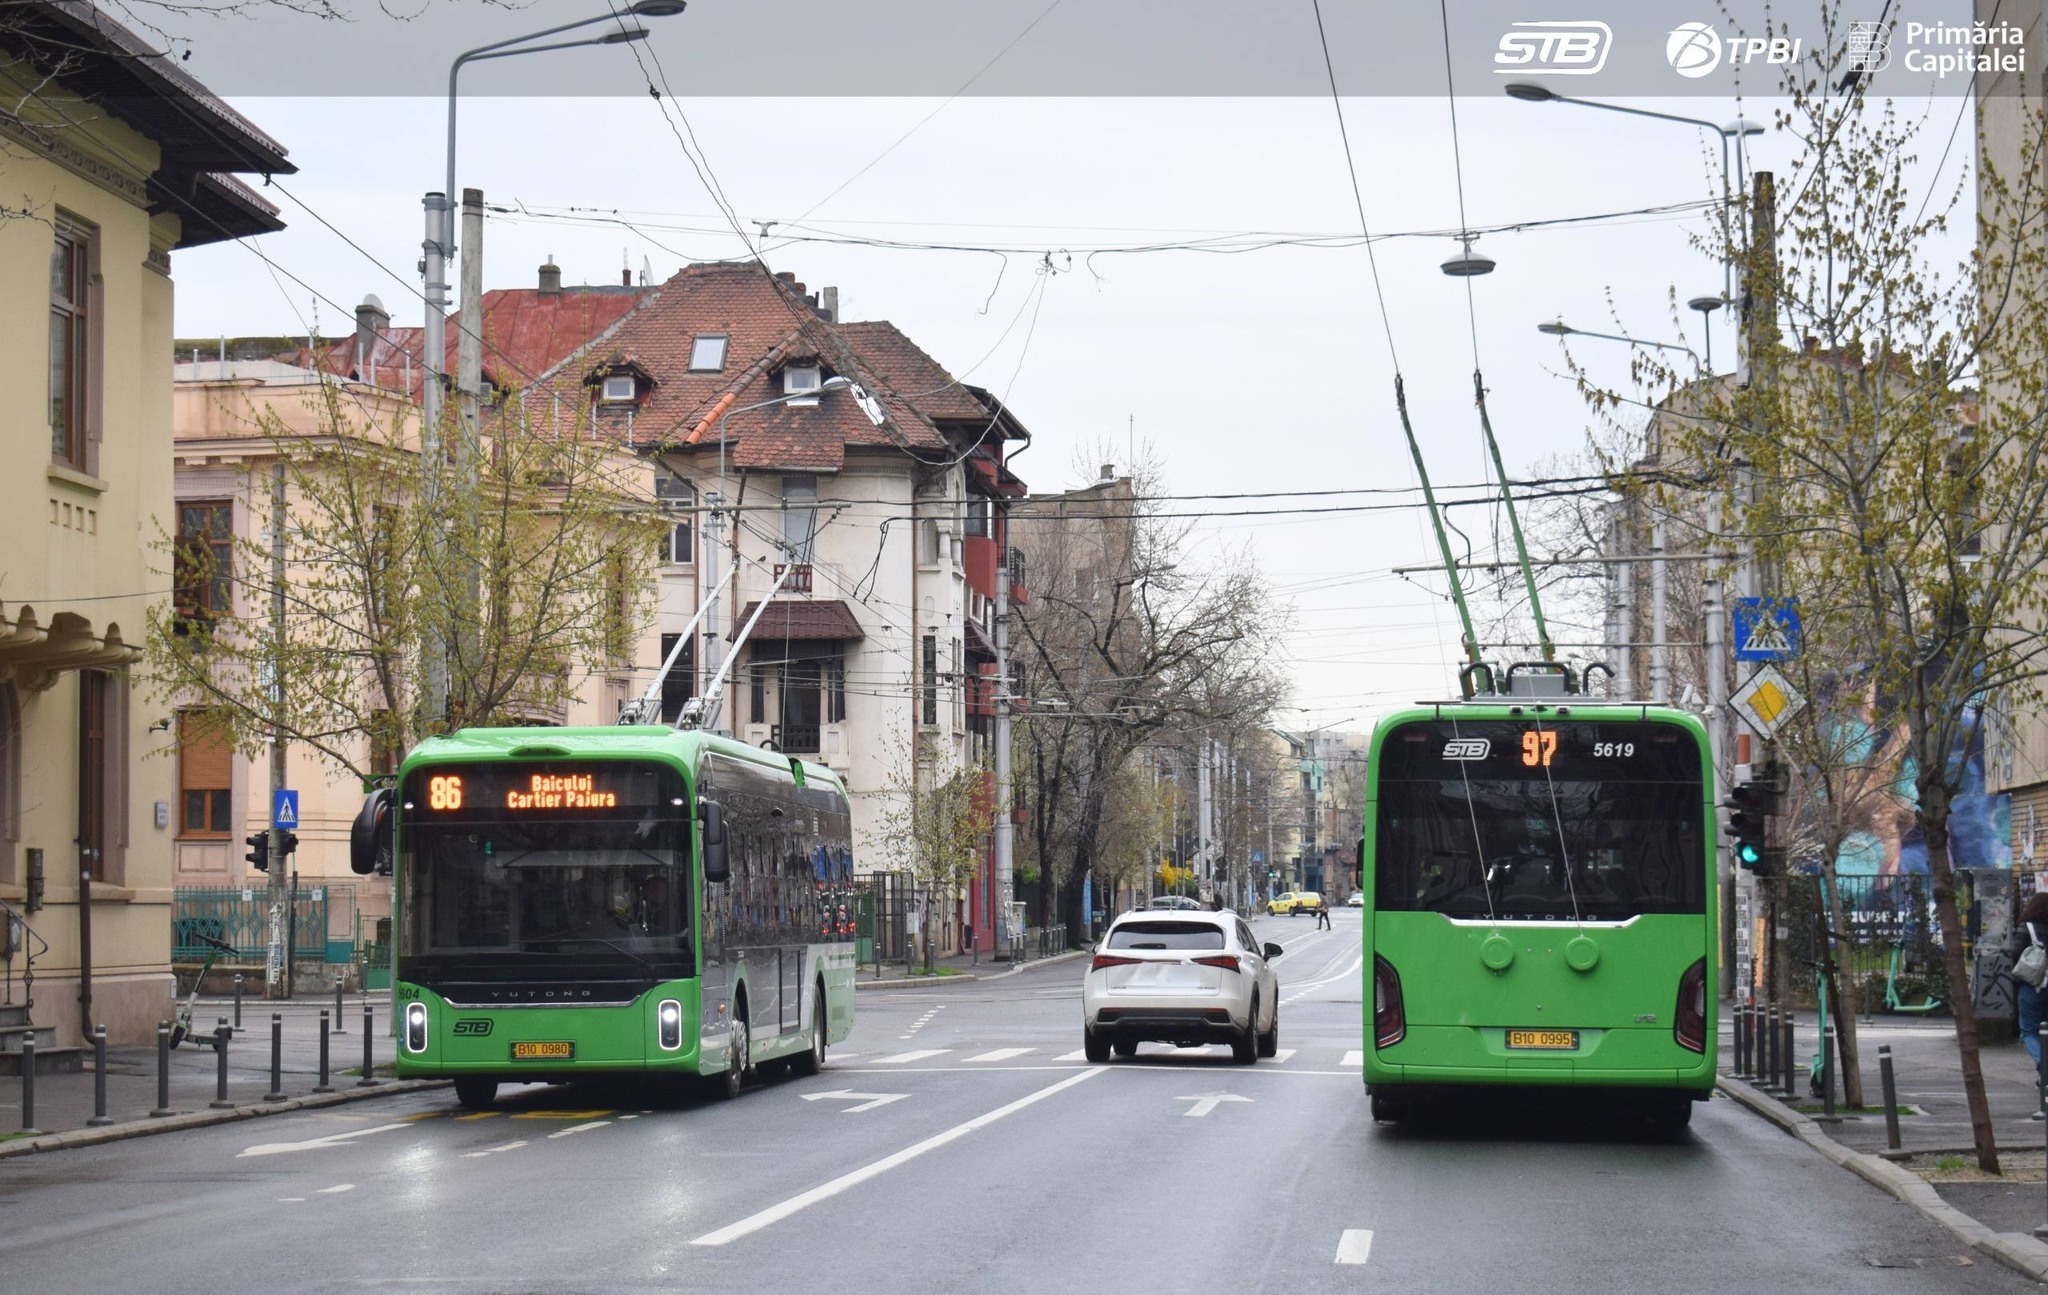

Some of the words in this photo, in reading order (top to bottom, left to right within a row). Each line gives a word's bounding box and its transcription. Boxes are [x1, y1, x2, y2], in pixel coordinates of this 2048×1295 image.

[1443, 742, 1484, 757] STB
[1522, 731, 1557, 766] 97
[1593, 742, 1634, 758] 5619
[531, 774, 592, 792] Baicului
[430, 776, 462, 809] 86
[507, 791, 562, 808] Cartier
[566, 791, 615, 808] Pajura
[1482, 913, 1597, 921] YUTONG
[1513, 1032, 1535, 1045] B10
[1540, 1032, 1571, 1045] 0995
[518, 1044, 537, 1055] B10
[541, 1043, 568, 1055] 0980
